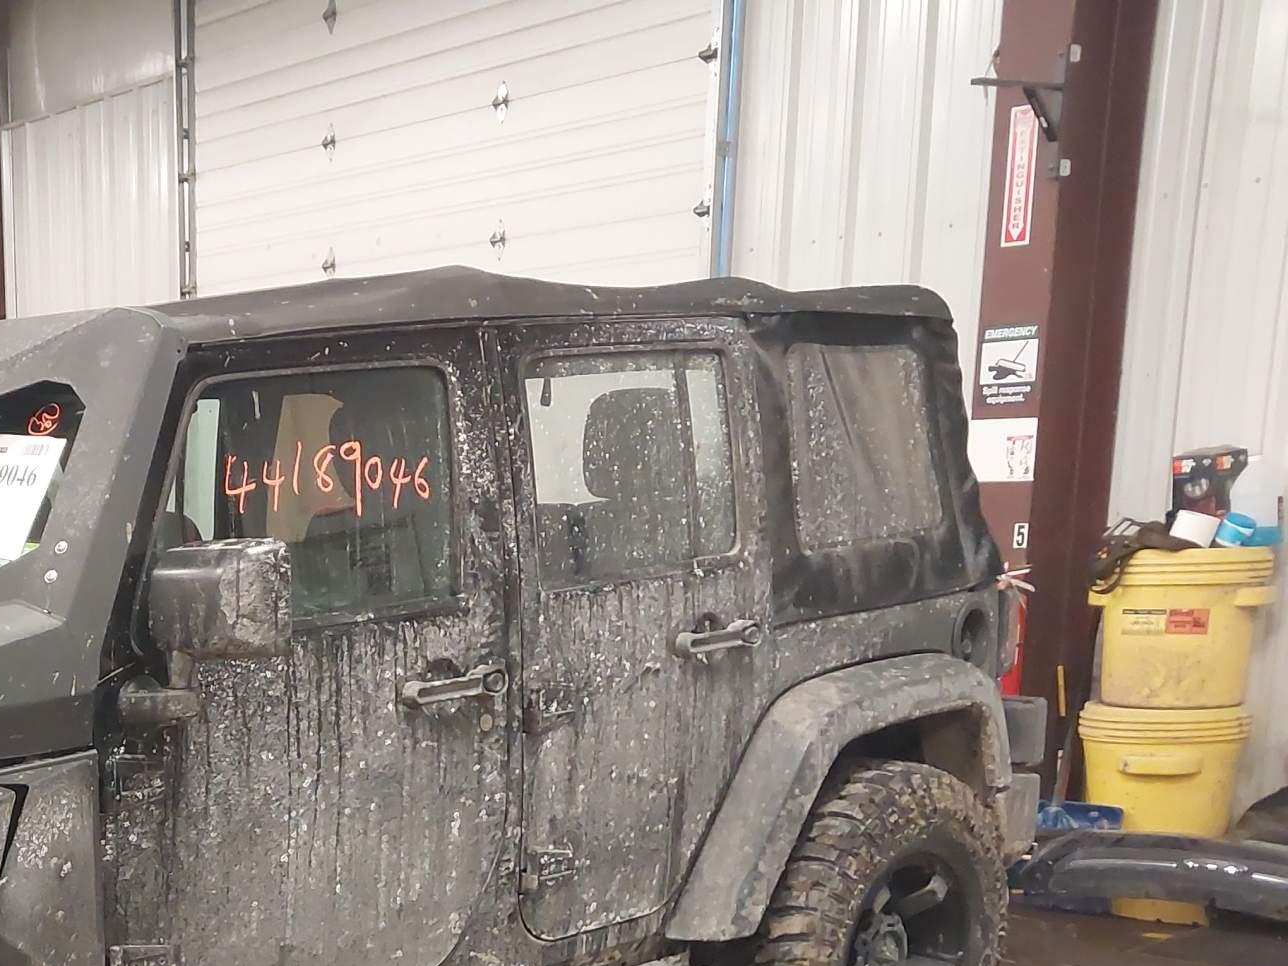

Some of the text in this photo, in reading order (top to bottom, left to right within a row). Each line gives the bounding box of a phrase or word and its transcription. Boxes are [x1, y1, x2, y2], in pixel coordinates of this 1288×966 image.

[1012, 130, 1027, 229] ETINGUISHER
[984, 326, 1038, 340] EMERGENCY
[223, 440, 430, 517] 44189046
[1016, 525, 1025, 547] 5
